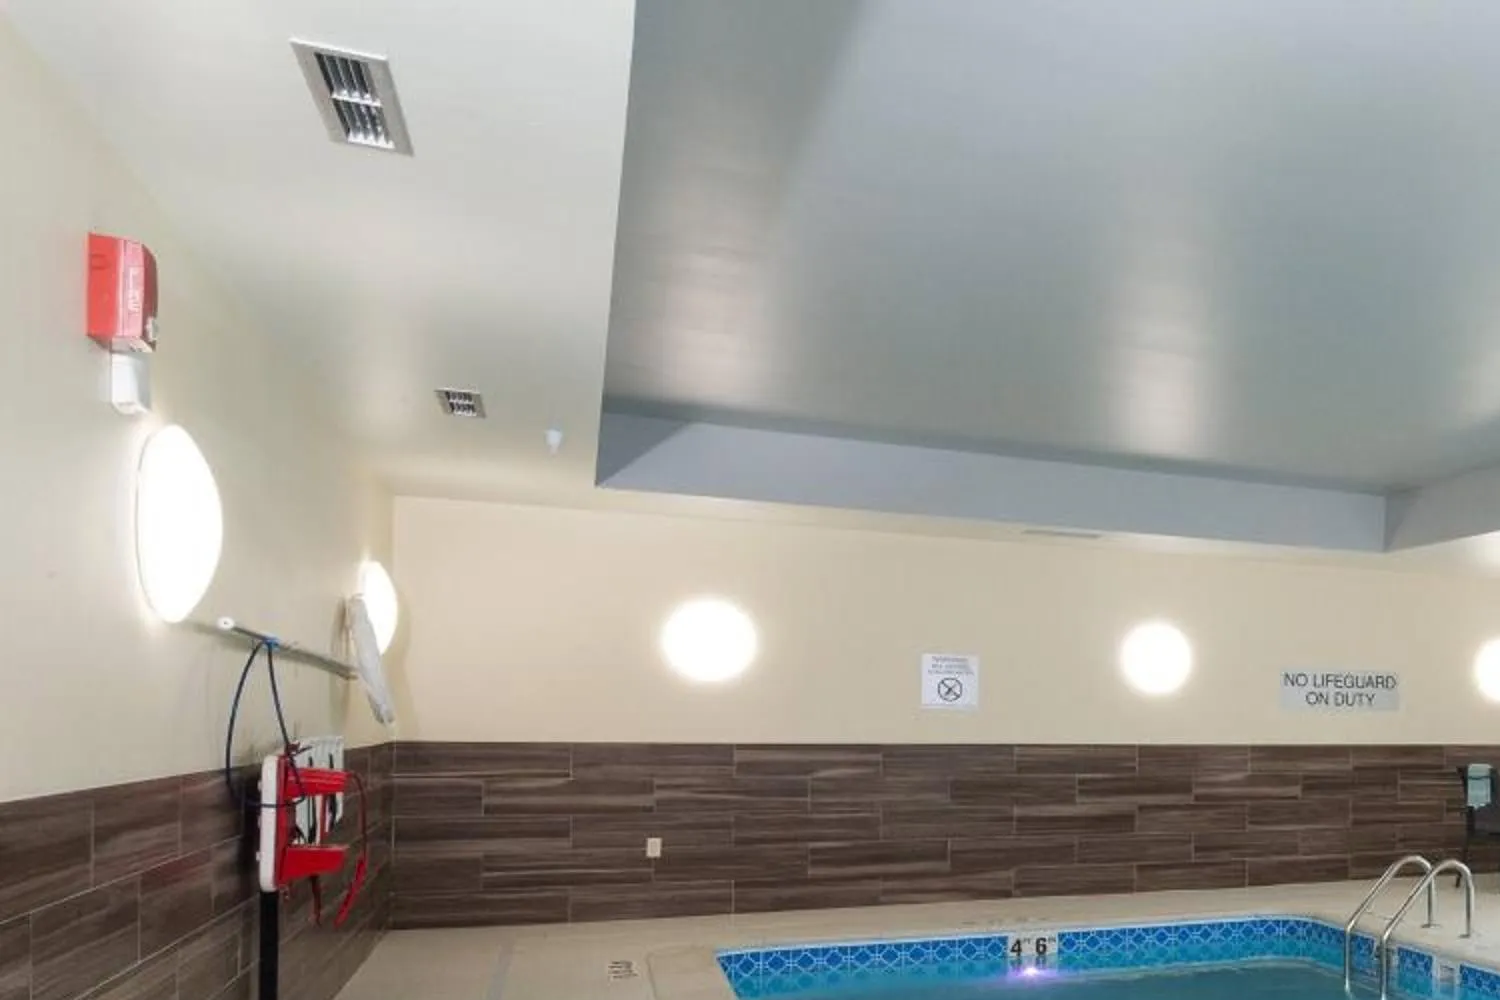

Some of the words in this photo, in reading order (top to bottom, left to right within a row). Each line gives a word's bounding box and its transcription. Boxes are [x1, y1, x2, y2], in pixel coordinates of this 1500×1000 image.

[1284, 673, 1308, 687] NO
[1313, 673, 1397, 689] LIFEGUARD
[1305, 691, 1329, 705] ON
[1334, 691, 1376, 707] DUTY
